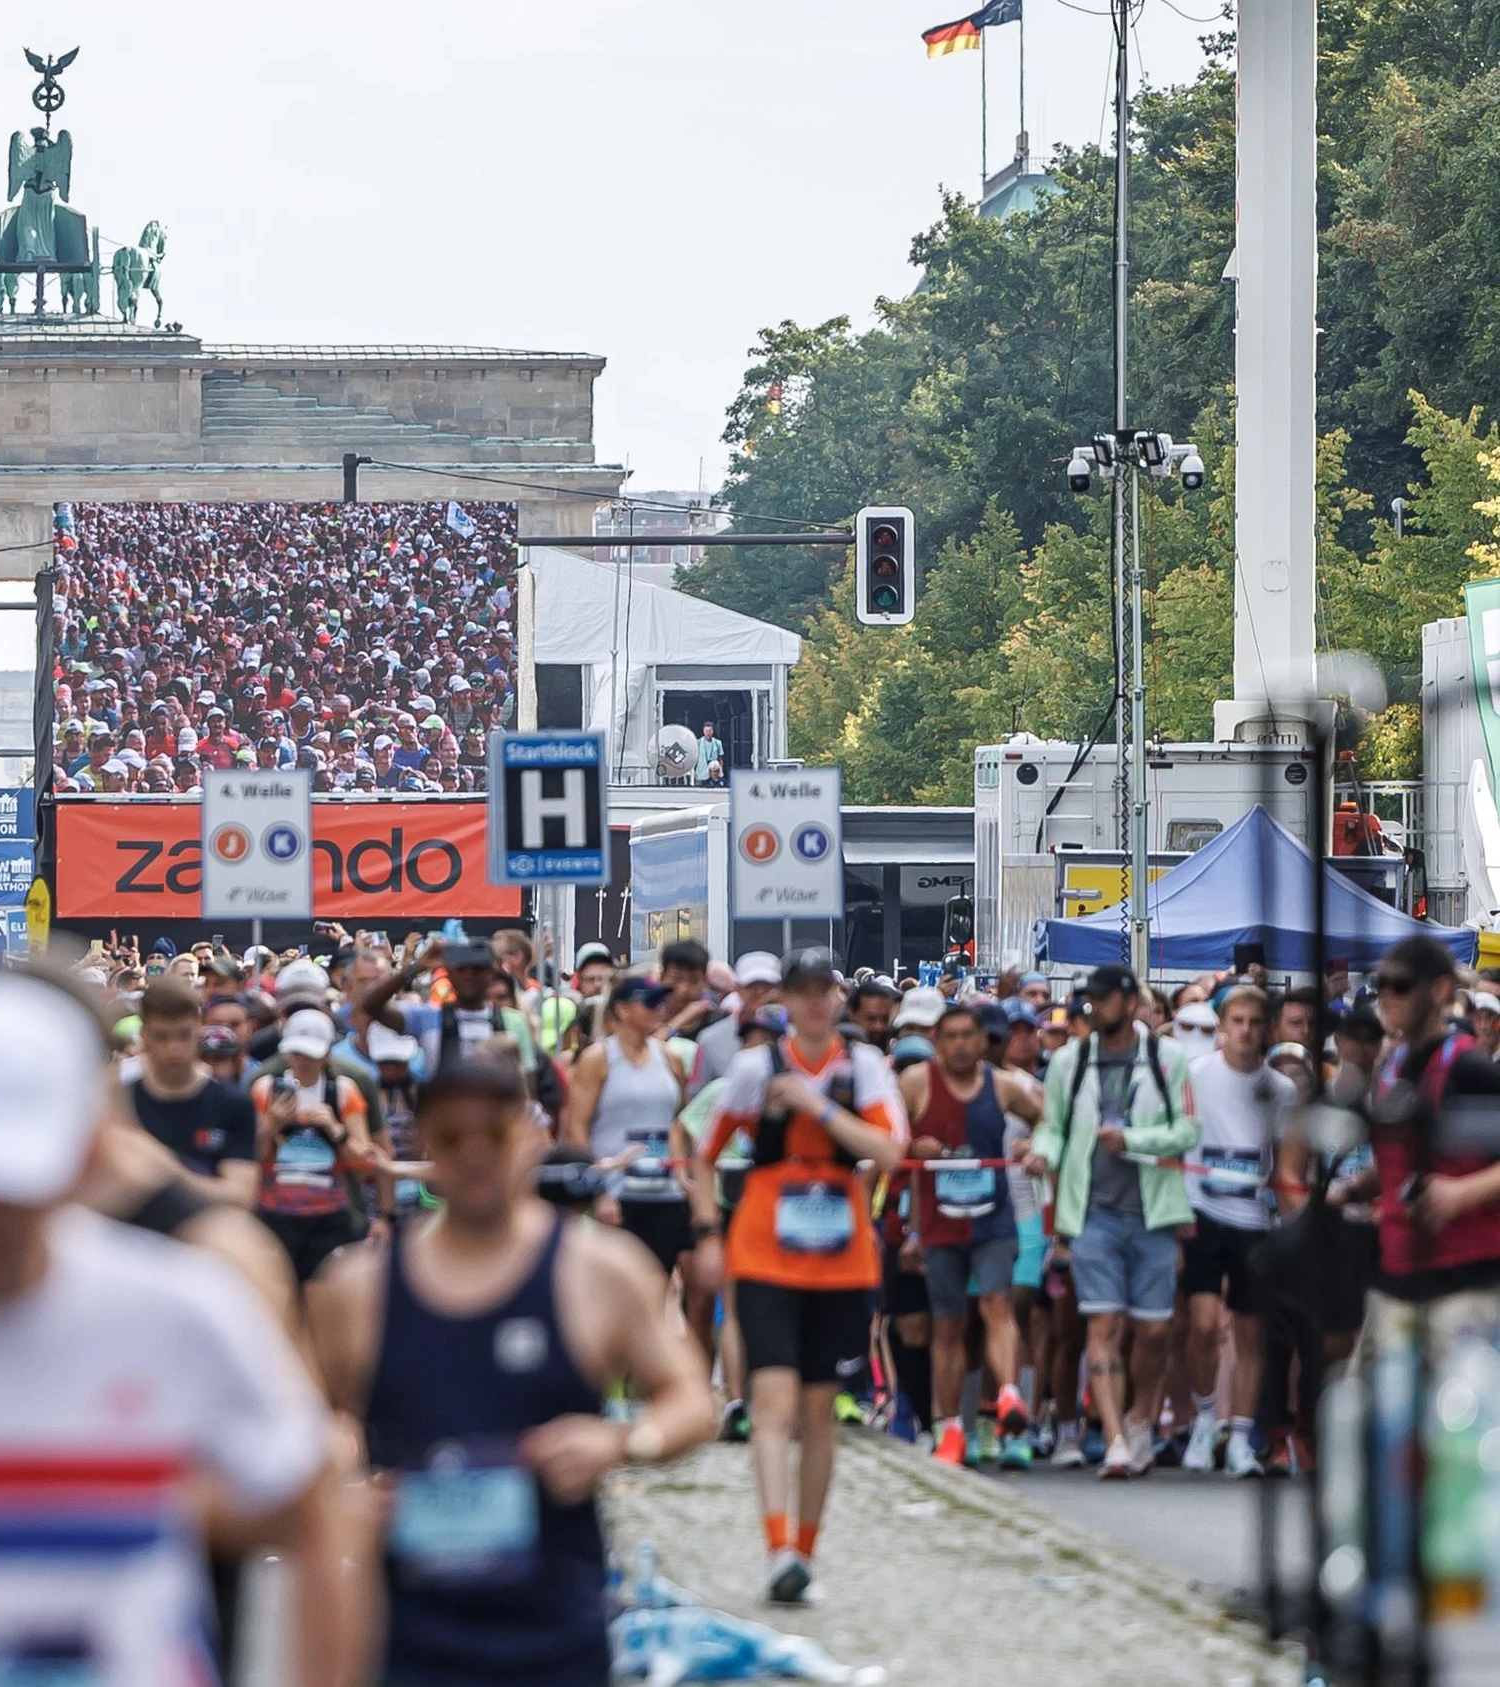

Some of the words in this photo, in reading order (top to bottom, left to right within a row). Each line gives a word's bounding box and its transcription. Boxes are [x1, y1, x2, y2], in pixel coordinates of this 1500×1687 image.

[506, 742, 597, 760] Startblock
[241, 782, 294, 798] Welle
[749, 783, 765, 798] 4.
[770, 783, 821, 798] Welle
[521, 768, 587, 849] H
[224, 834, 239, 855] J
[274, 832, 292, 854] K
[754, 834, 768, 855] J
[803, 833, 821, 854] K
[115, 827, 463, 894] zando
